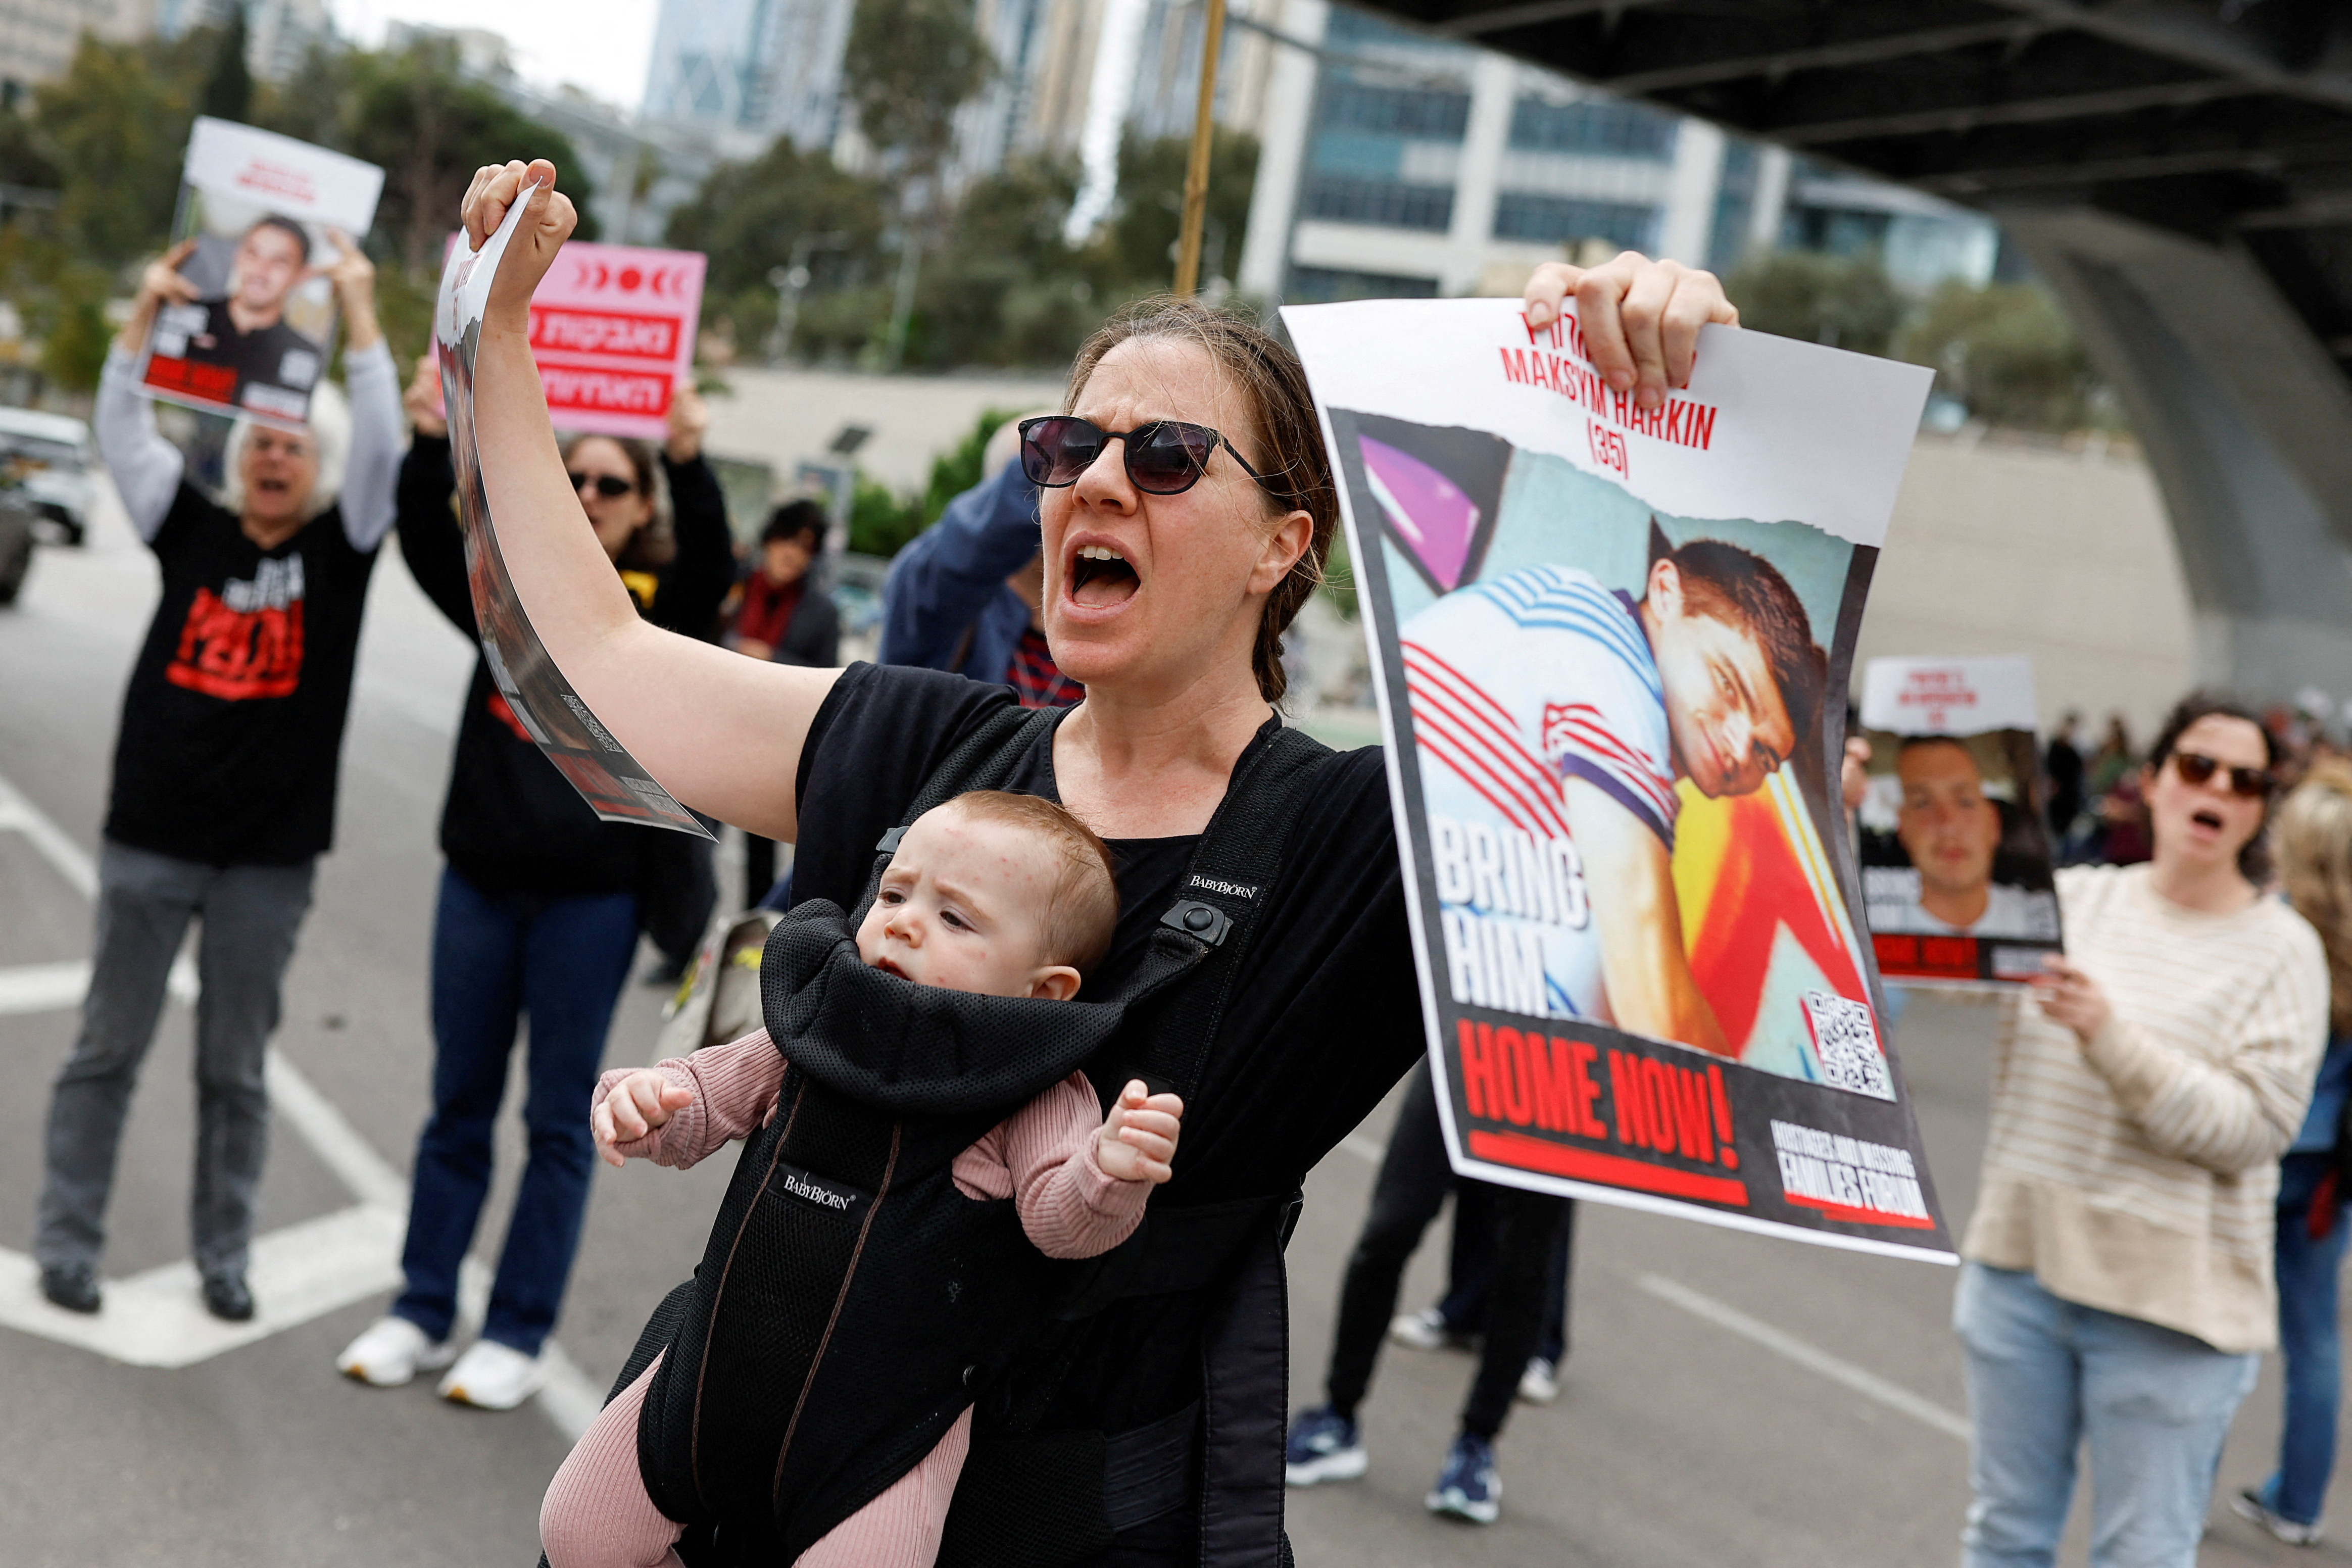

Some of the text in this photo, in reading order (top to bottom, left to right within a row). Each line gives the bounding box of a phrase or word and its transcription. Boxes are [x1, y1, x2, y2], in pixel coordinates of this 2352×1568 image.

[1500, 348, 1607, 418] MAKSYM
[1613, 388, 1717, 451] HARKIN
[1588, 417, 1629, 480] (35)
[1433, 815, 1589, 929] BRING
[1442, 912, 1550, 1019] HIM
[1457, 1018, 1739, 1171] HOME NOW!
